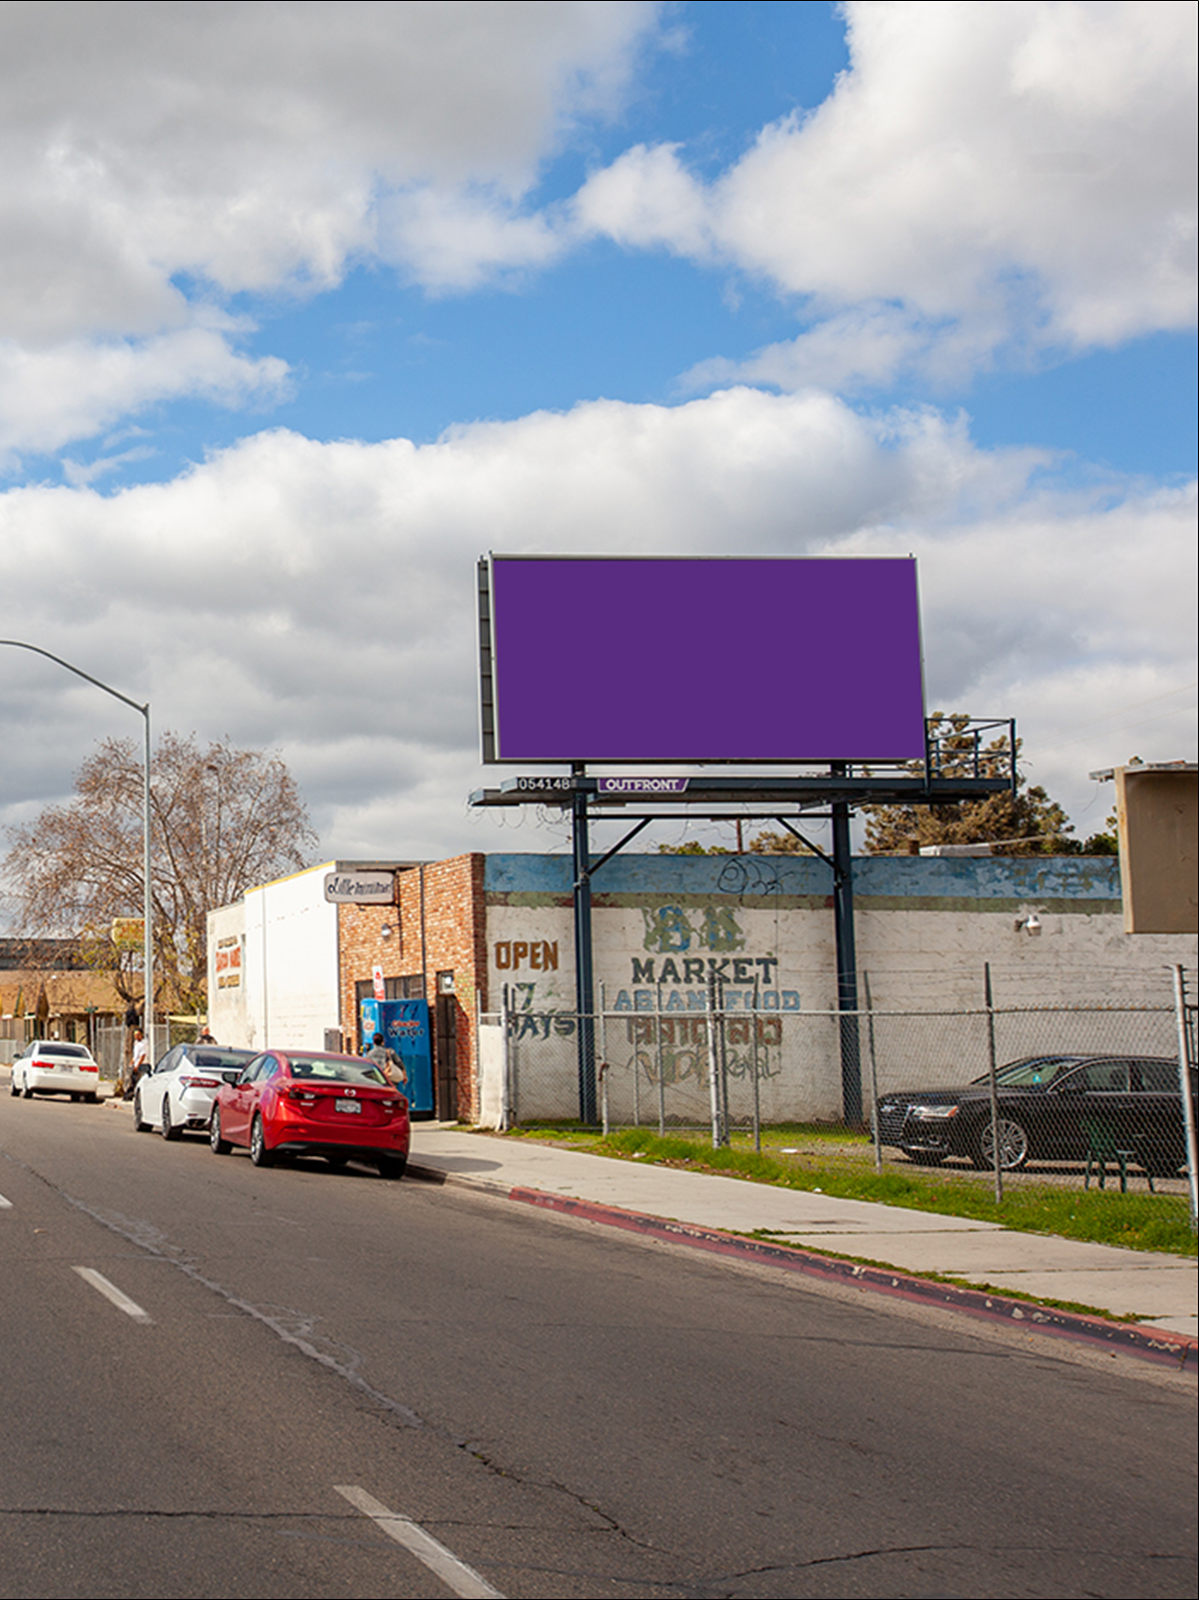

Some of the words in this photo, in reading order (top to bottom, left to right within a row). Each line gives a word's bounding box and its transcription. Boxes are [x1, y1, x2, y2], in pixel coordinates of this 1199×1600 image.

[605, 778, 680, 791] OUTFRONT
[494, 939, 559, 973] OPEN
[631, 956, 779, 985] MARKET
[514, 982, 537, 1011] 7
[723, 989, 801, 1012] FOOD
[387, 1026, 425, 1038] Water
